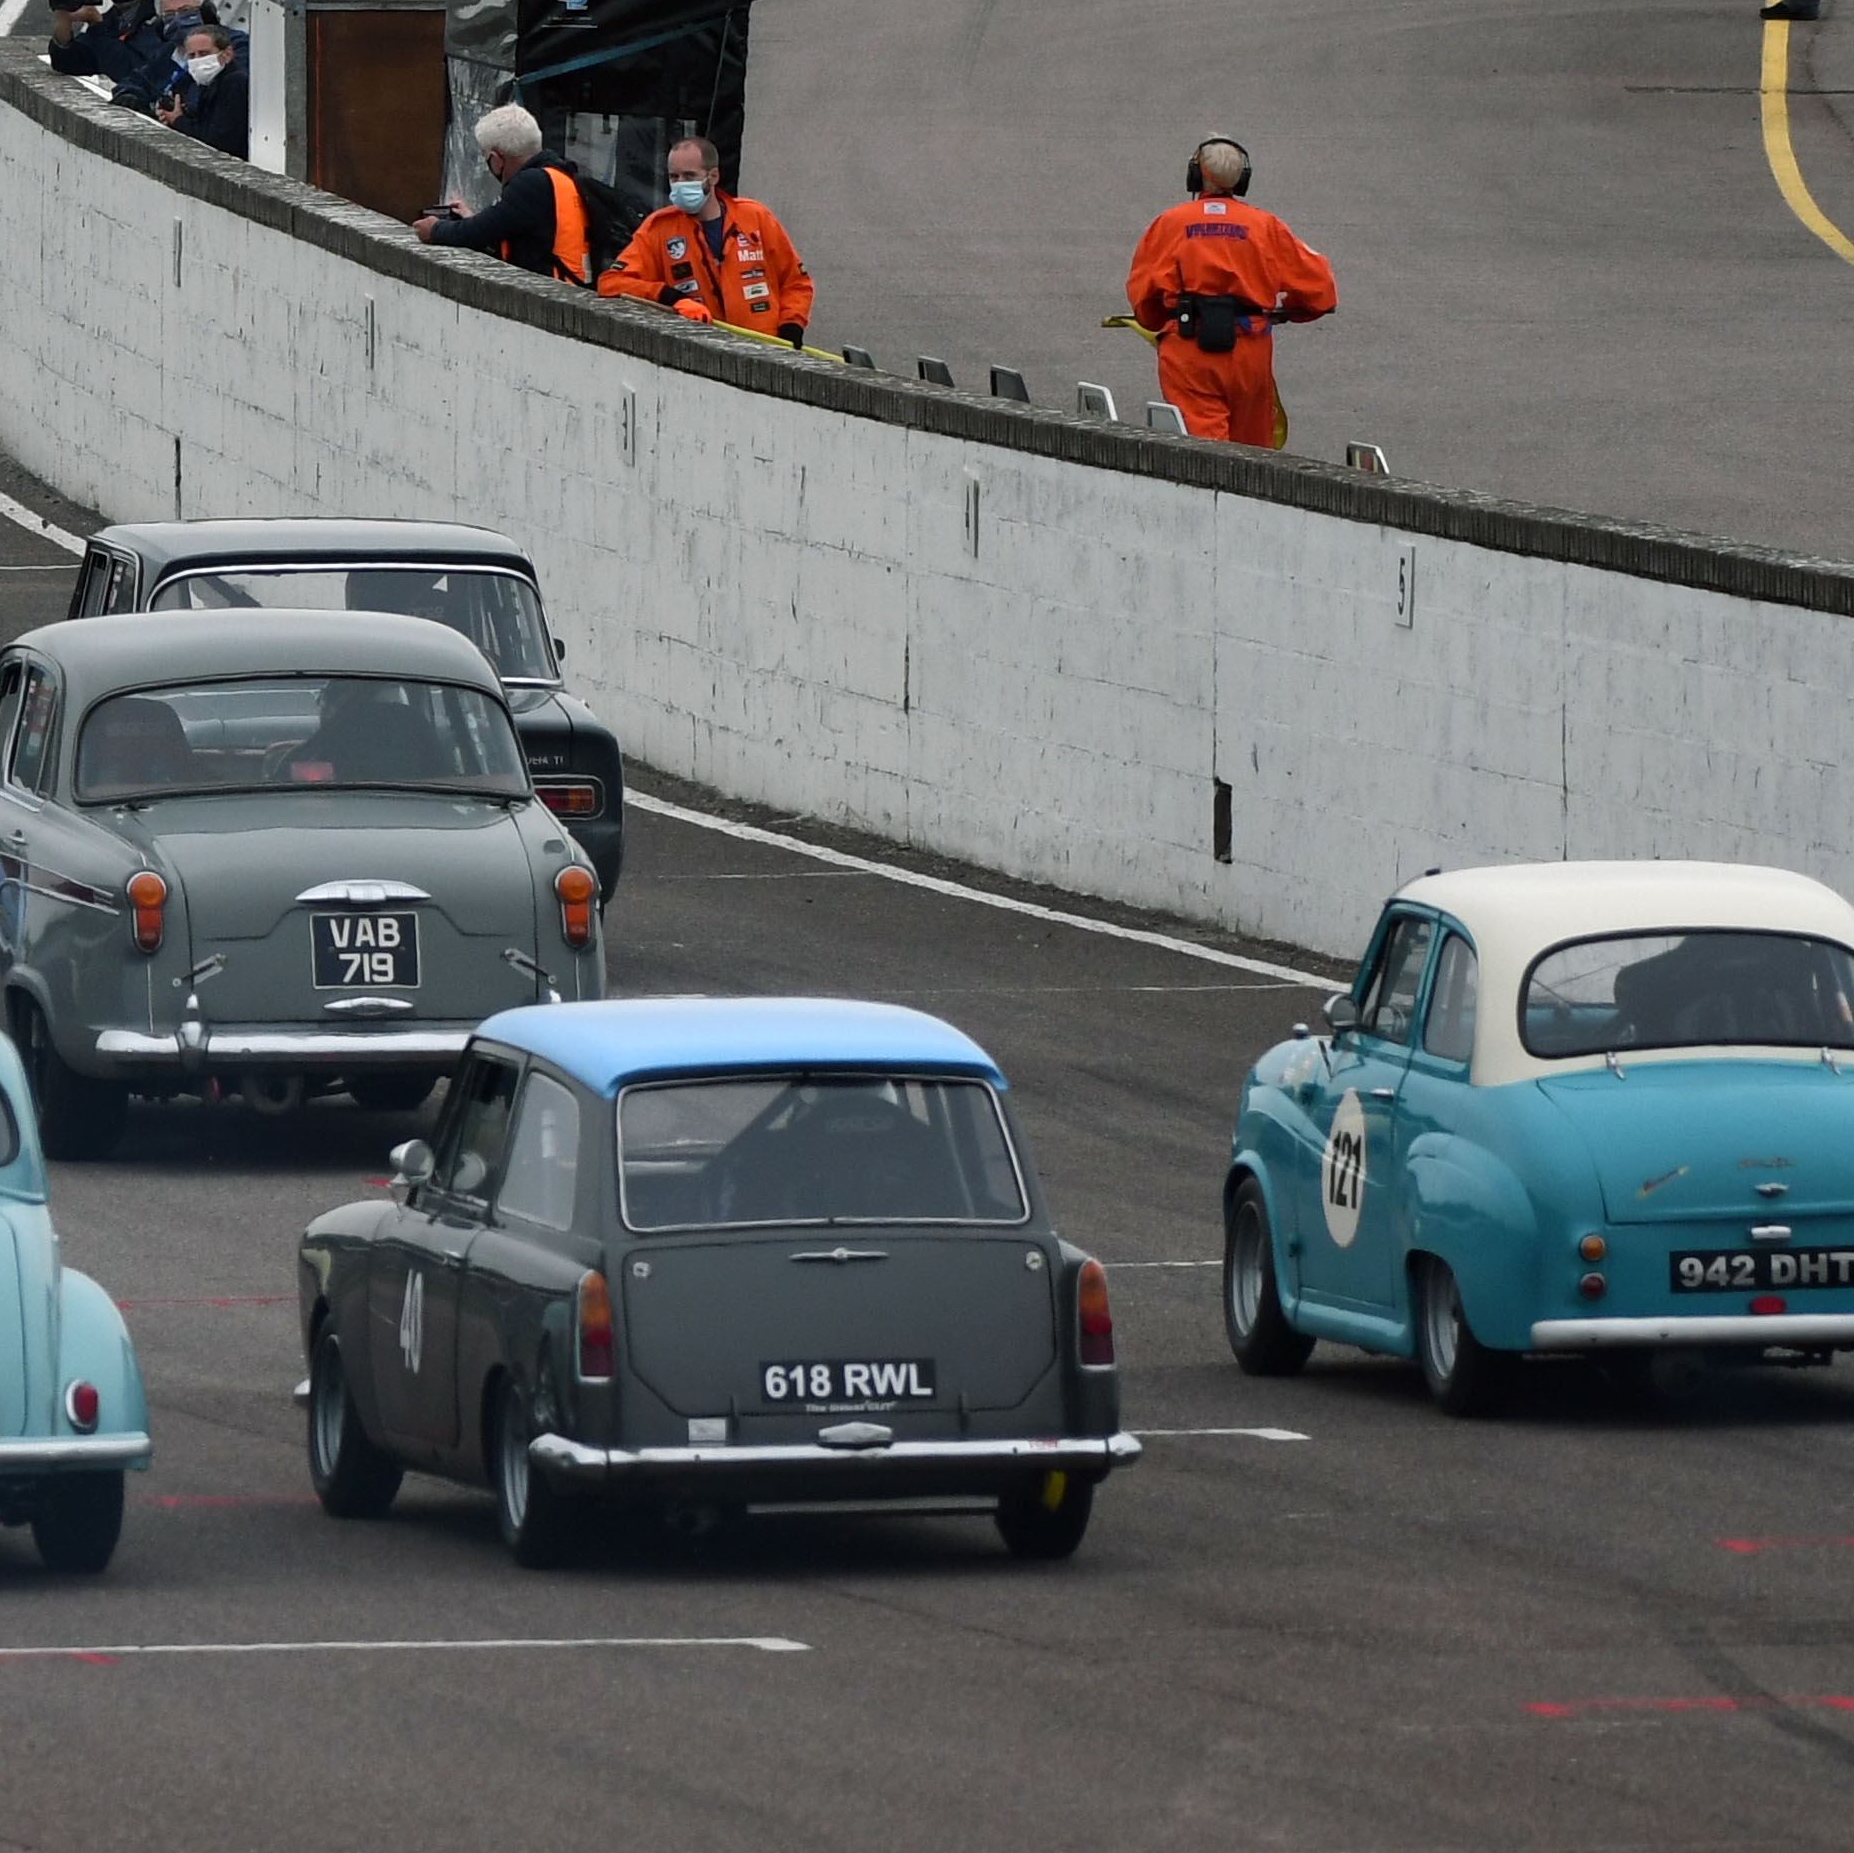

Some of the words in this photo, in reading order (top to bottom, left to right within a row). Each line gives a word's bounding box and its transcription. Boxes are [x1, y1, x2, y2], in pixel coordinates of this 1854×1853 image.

[737, 249, 764, 262] Matt
[1396, 557, 1406, 616] 5
[329, 917, 401, 949] VAB
[338, 952, 395, 983] 719
[1330, 1131, 1362, 1209] 121
[1679, 1255, 1757, 1288] 942
[1770, 1252, 1854, 1286] DHT
[399, 1267, 423, 1374] 40
[763, 1363, 831, 1400] 618
[844, 1362, 934, 1400] RWL
